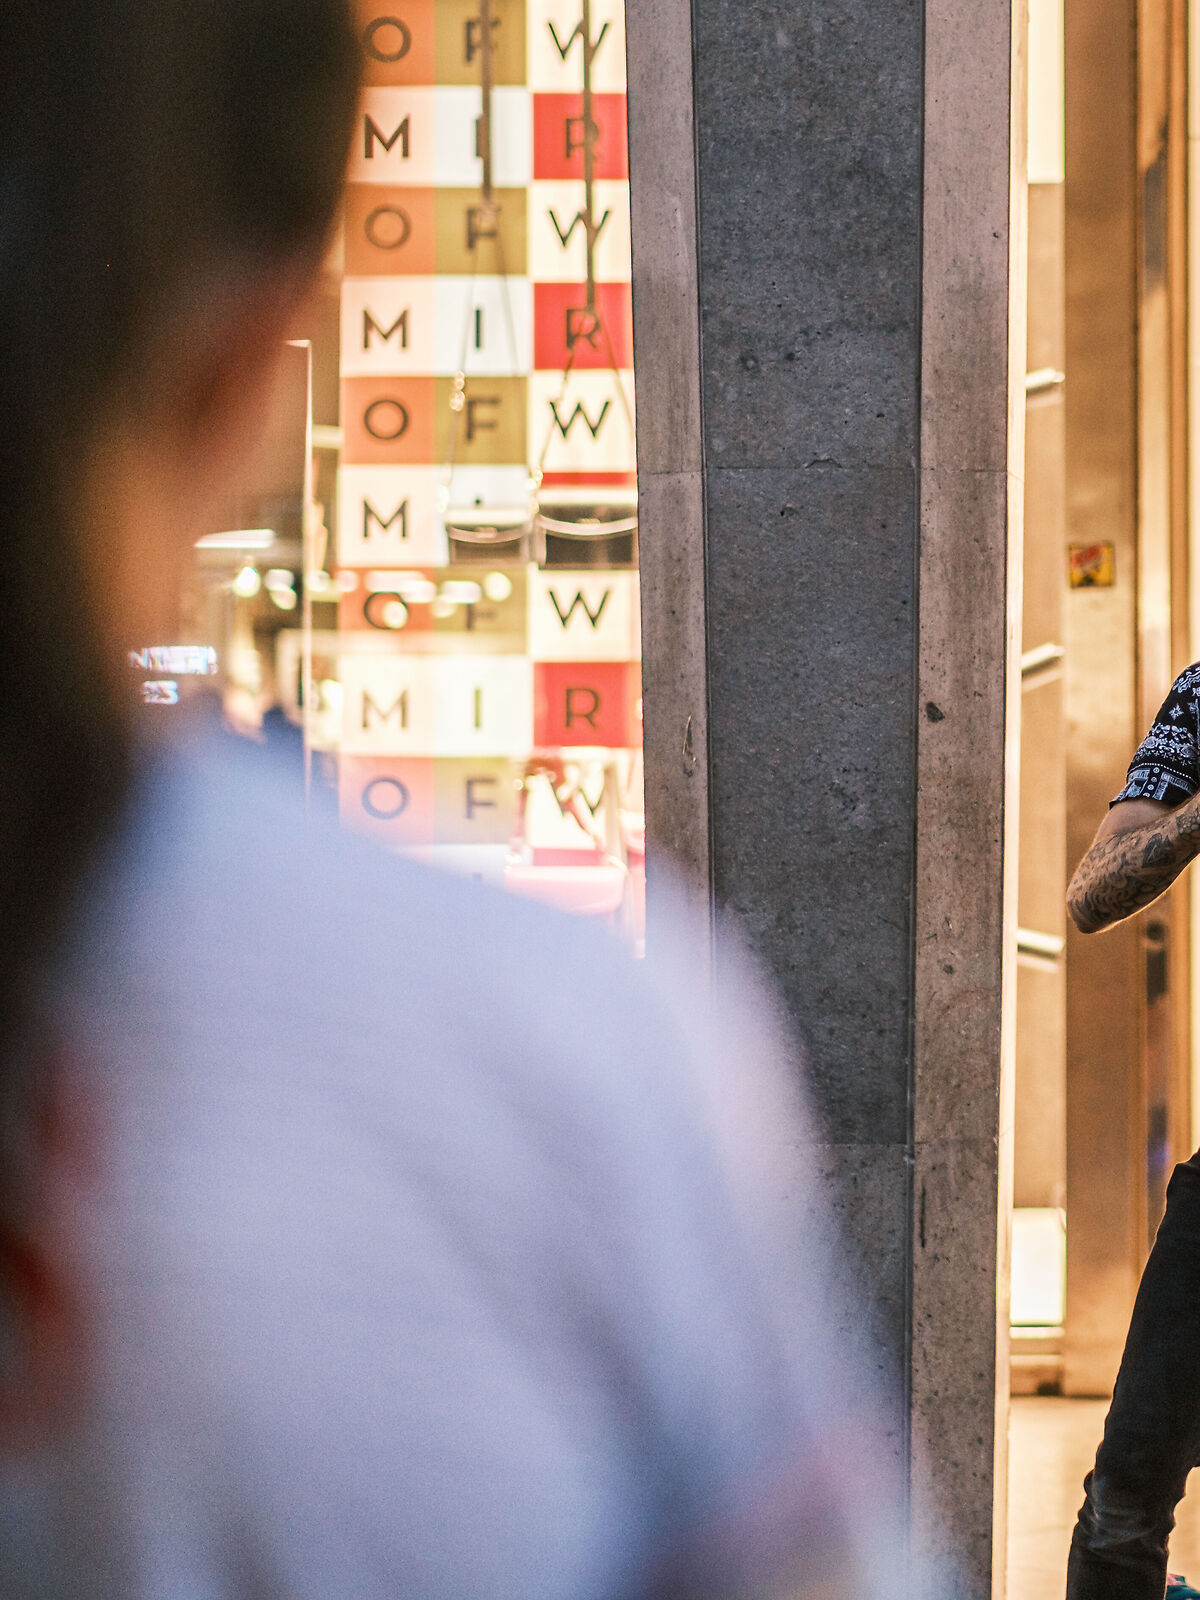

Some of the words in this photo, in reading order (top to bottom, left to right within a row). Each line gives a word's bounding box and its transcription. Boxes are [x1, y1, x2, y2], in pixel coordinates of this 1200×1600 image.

[364, 16, 411, 63] O
[364, 114, 410, 158] M
[364, 205, 411, 250] O
[363, 309, 408, 349] M
[364, 399, 408, 440] O
[466, 397, 500, 441] F
[550, 401, 609, 438] W
[363, 498, 408, 539] M
[549, 590, 609, 627] W
[362, 689, 409, 730] M
[565, 688, 600, 729] R
[362, 777, 409, 819] O
[466, 778, 497, 819] F
